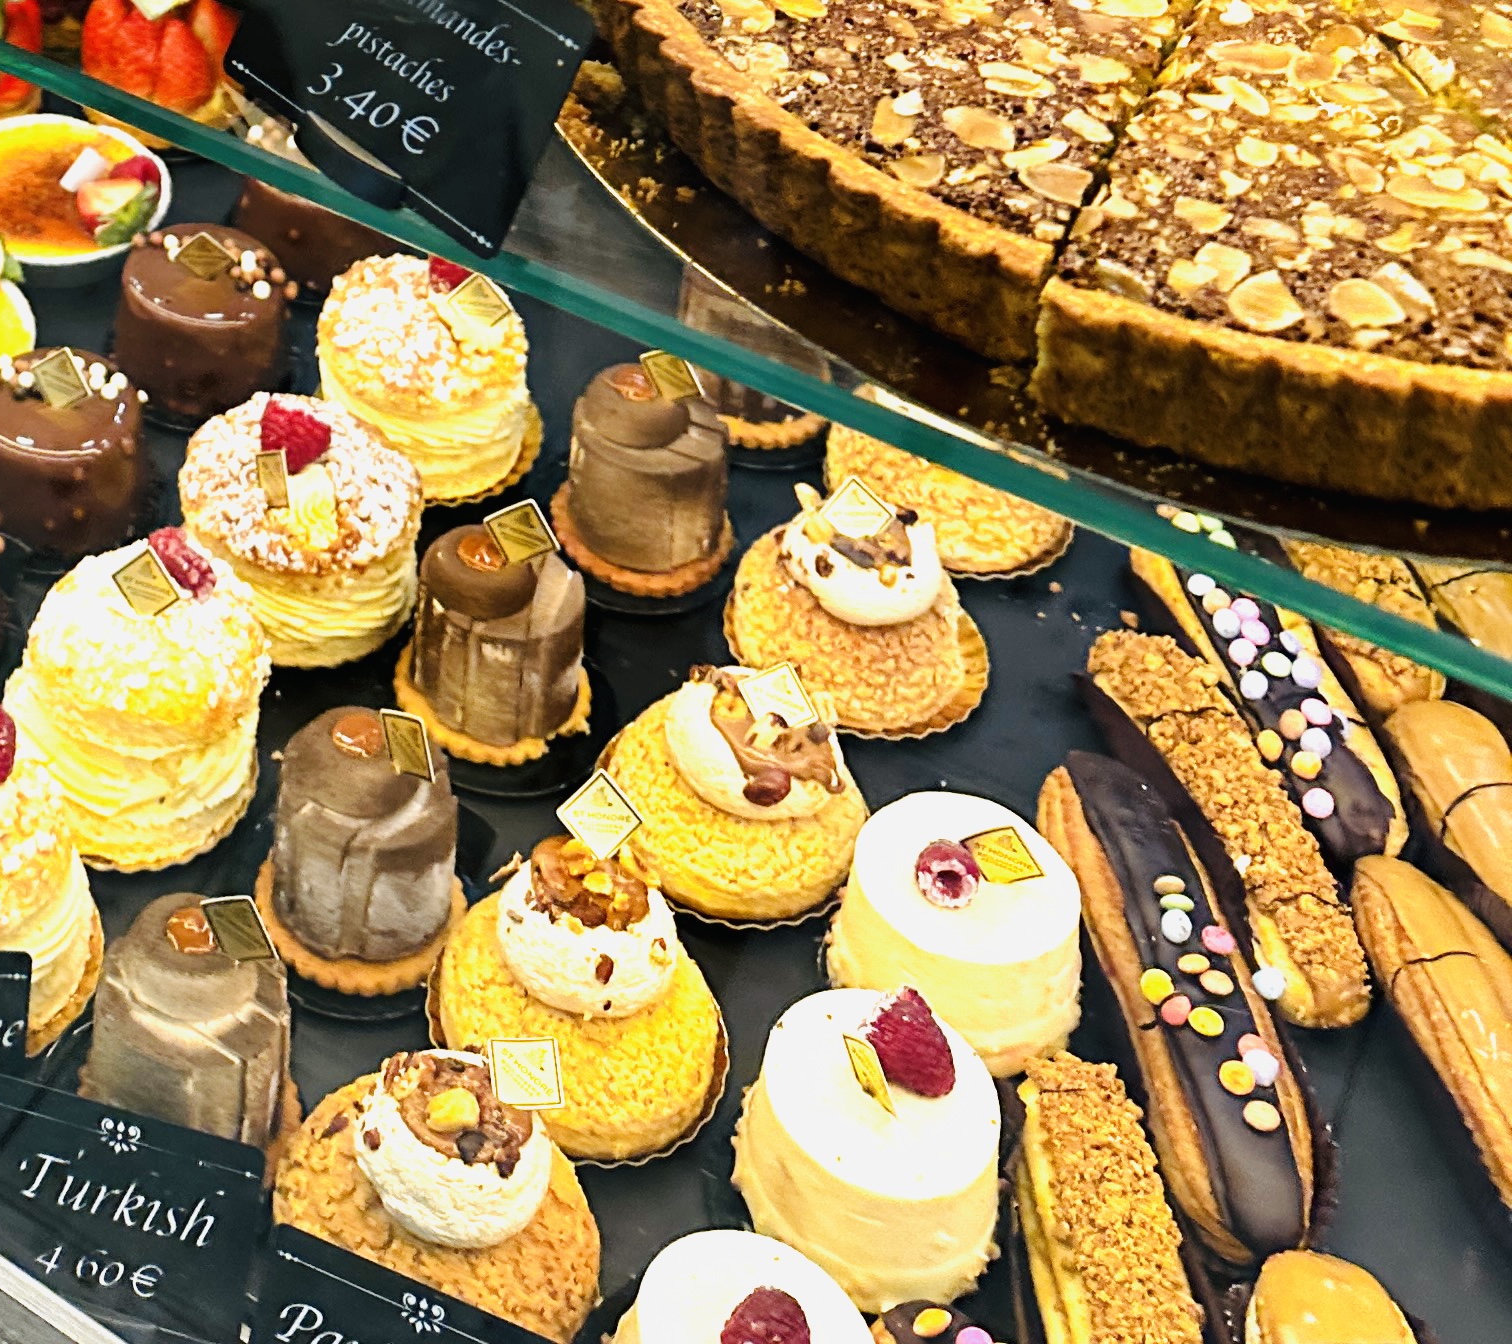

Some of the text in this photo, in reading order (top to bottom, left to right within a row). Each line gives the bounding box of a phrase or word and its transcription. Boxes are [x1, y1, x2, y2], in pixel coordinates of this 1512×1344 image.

[326, 20, 456, 103] pistaches
[306, 62, 440, 155] 3.40€
[19, 1148, 217, 1248] Turkish
